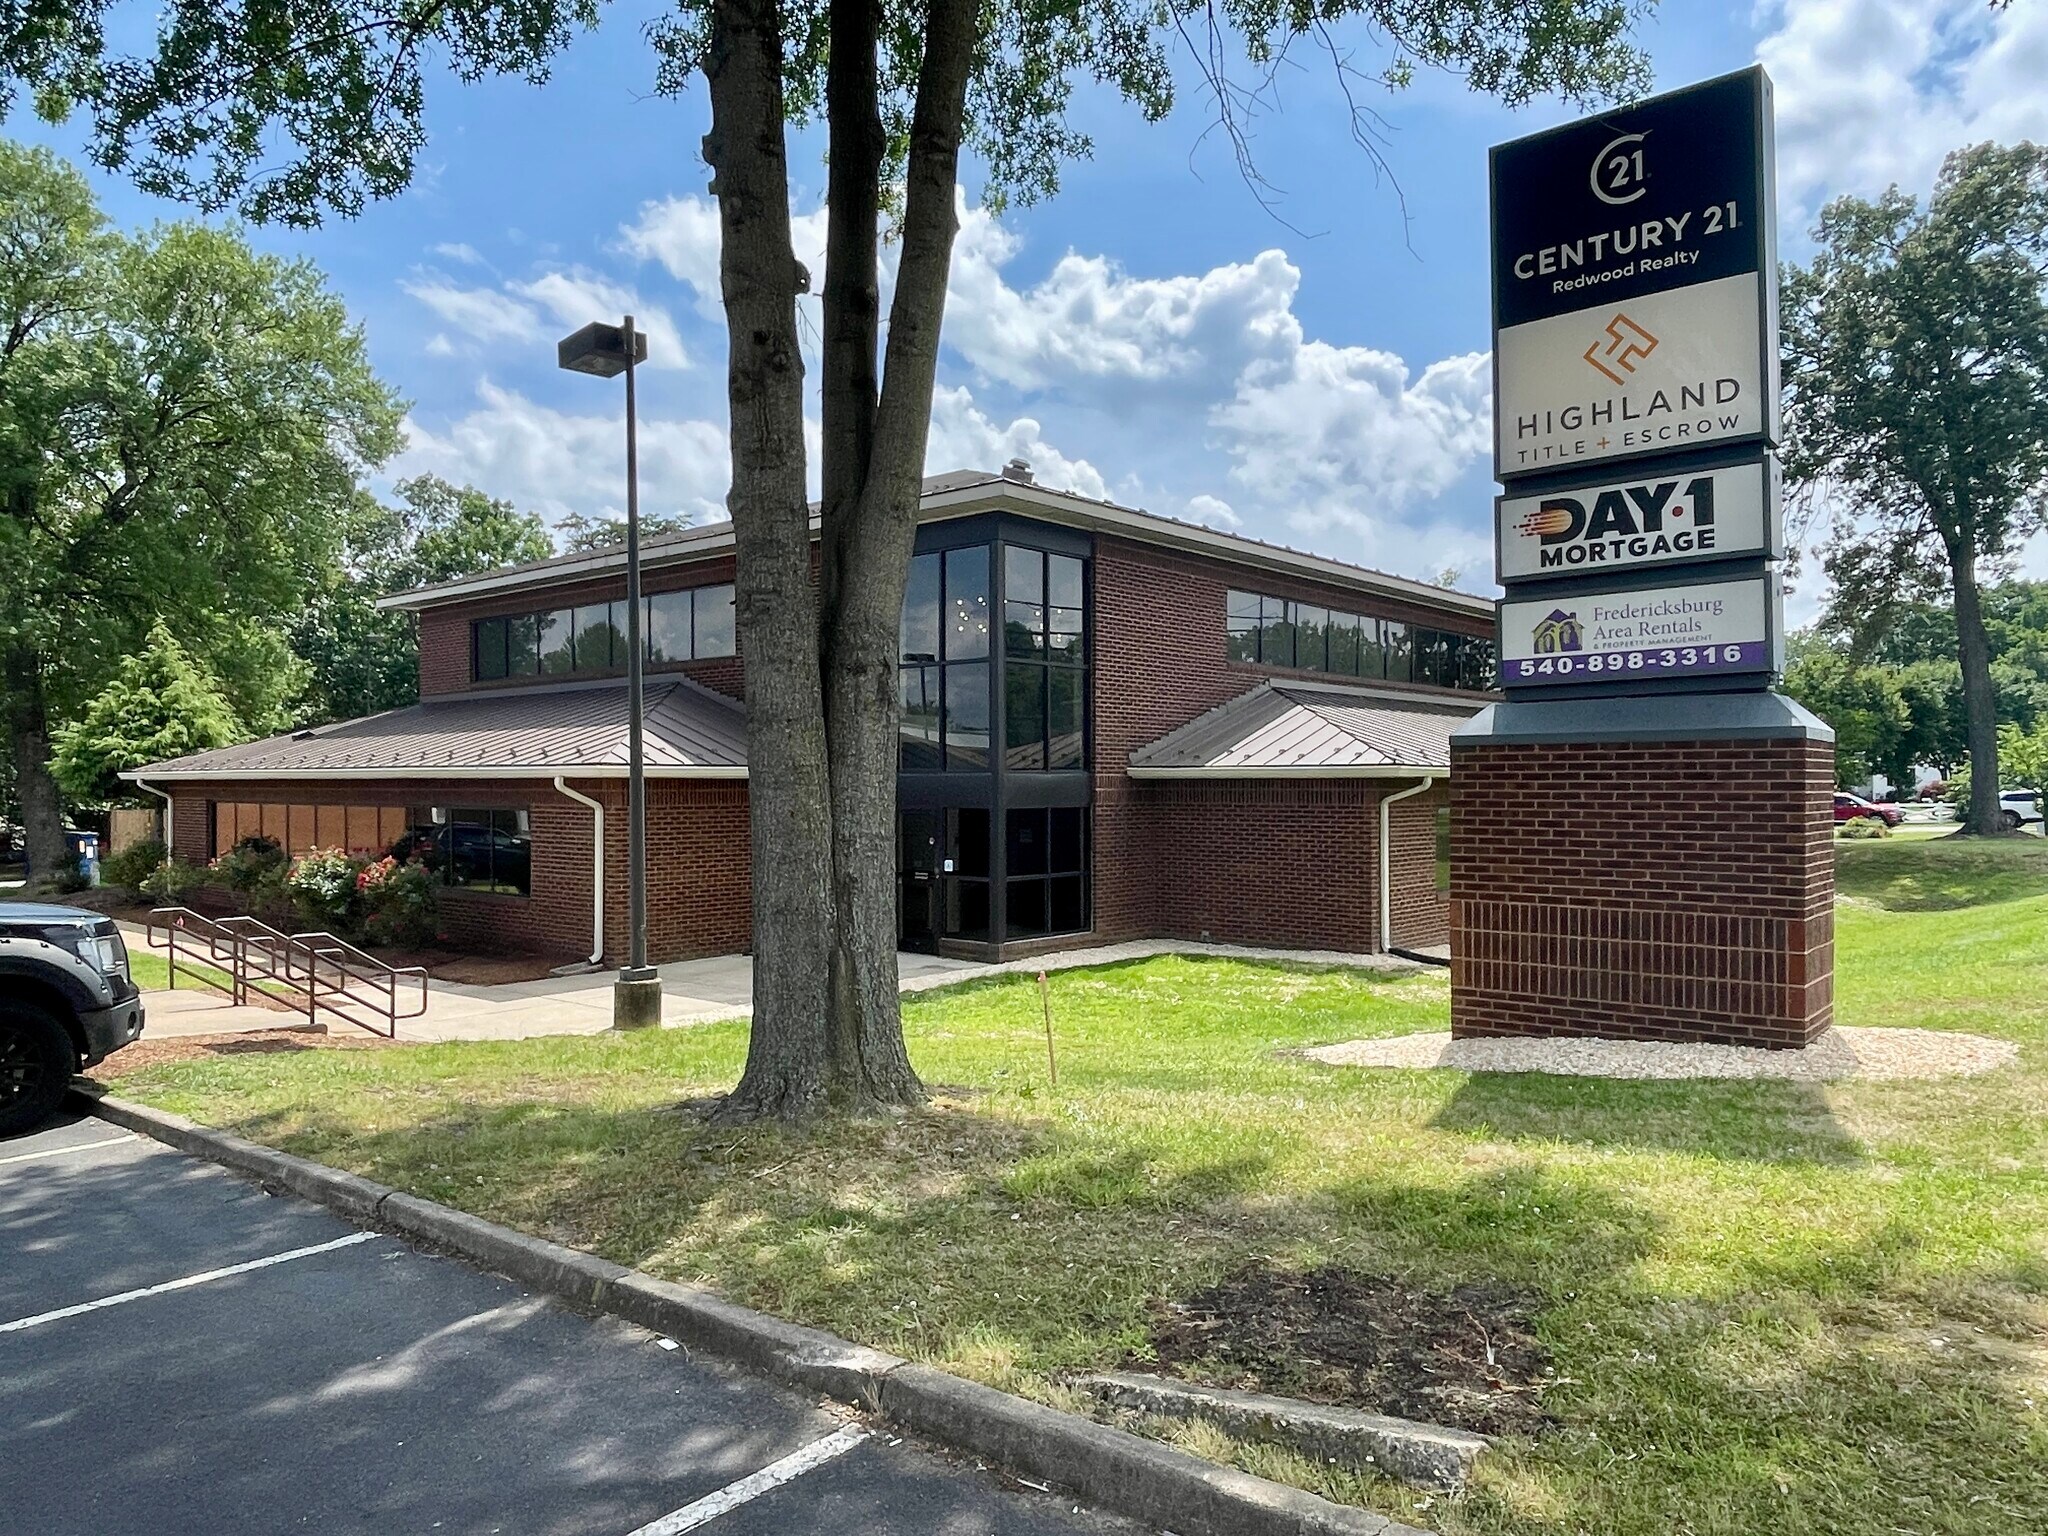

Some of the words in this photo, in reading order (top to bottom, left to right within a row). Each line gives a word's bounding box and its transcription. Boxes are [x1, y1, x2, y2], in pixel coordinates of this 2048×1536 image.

[1513, 211, 1692, 280] CENTURY
[1702, 201, 1738, 235] 21
[1553, 262, 1634, 294] Redwood
[1640, 250, 1700, 273] Realty
[1517, 378, 1741, 440] HIGHLAND
[1517, 440, 1586, 464] TITLE
[1623, 414, 1740, 446] ESCROW
[1540, 528, 1716, 568] MORTGAGE
[1593, 599, 1724, 622] Fredericksburg
[1593, 623, 1634, 641] Area
[1638, 617, 1703, 637] Rentals
[1519, 644, 1742, 677] 540-898-3316
[1602, 638, 1645, 649] PROPERTY
[1647, 633, 1713, 646] MANAGEMENT
